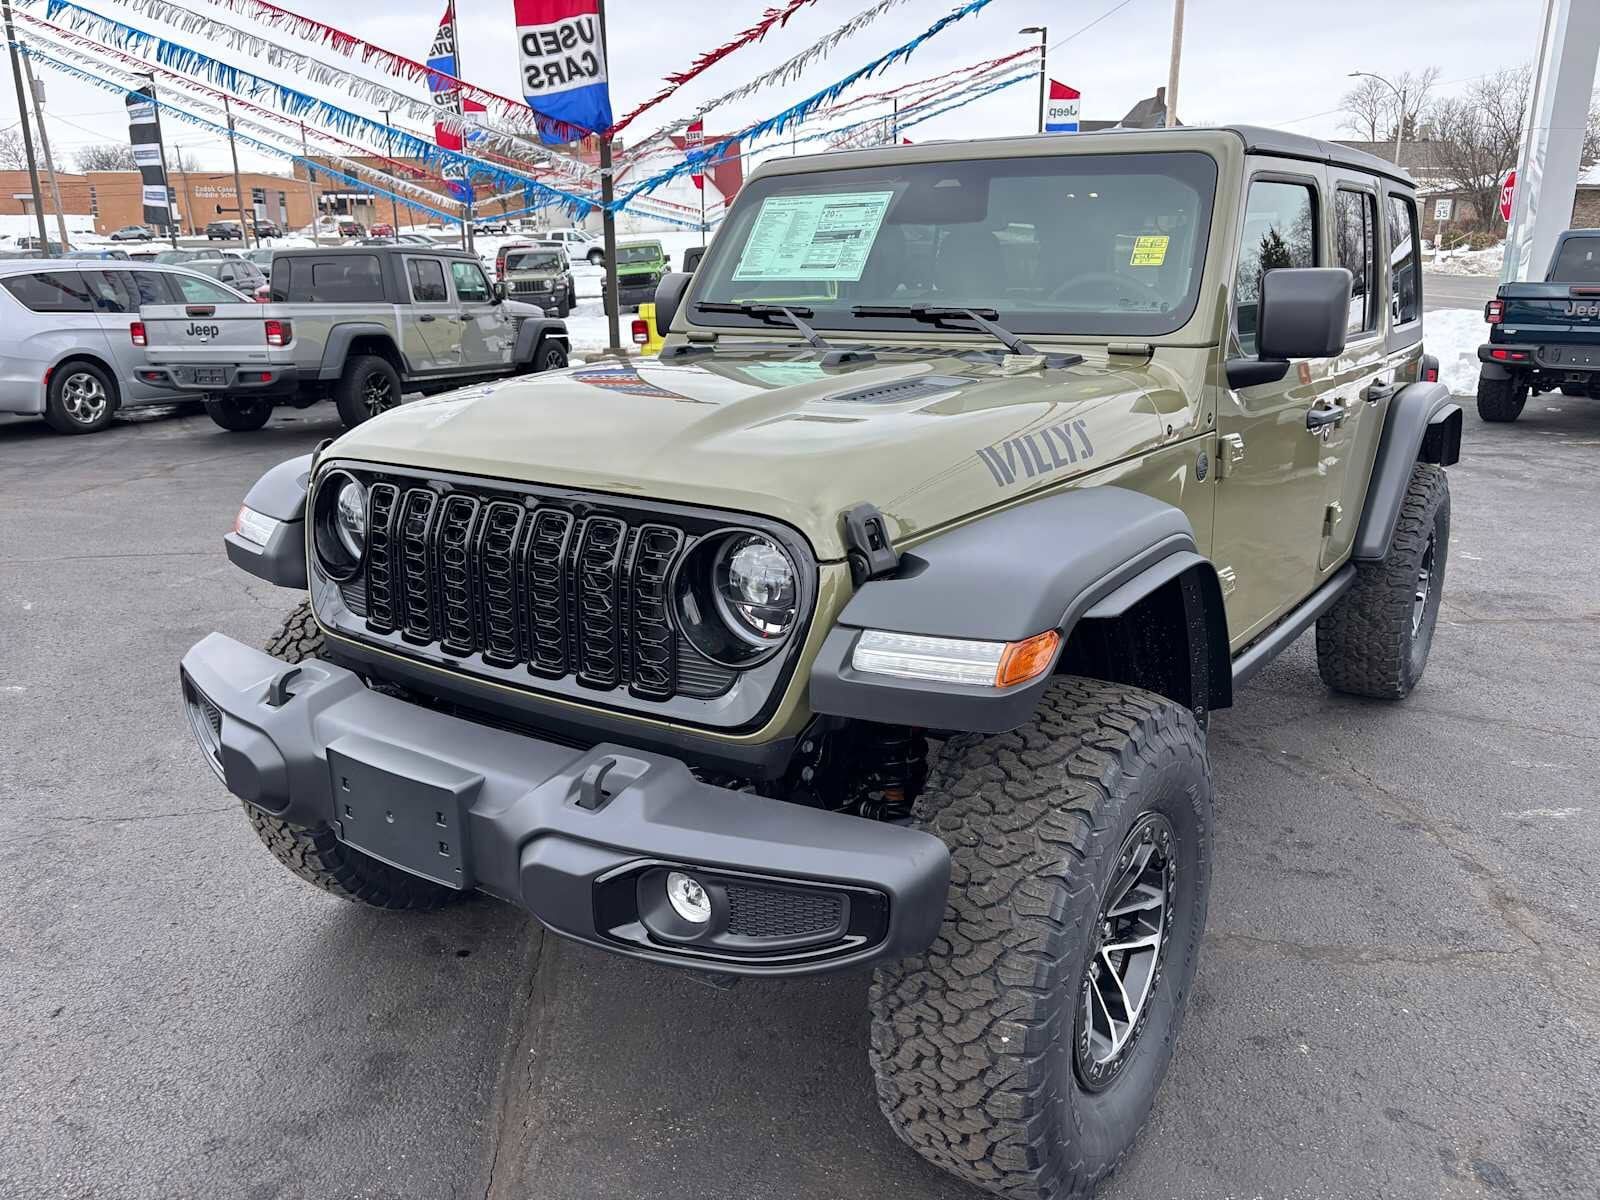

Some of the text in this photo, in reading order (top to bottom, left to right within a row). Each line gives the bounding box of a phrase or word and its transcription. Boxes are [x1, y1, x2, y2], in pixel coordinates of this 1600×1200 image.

[1502, 187, 1514, 205] ST
[1436, 209, 1448, 218] 35
[186, 322, 219, 338] Jeep
[976, 419, 1094, 487] WILLYS
